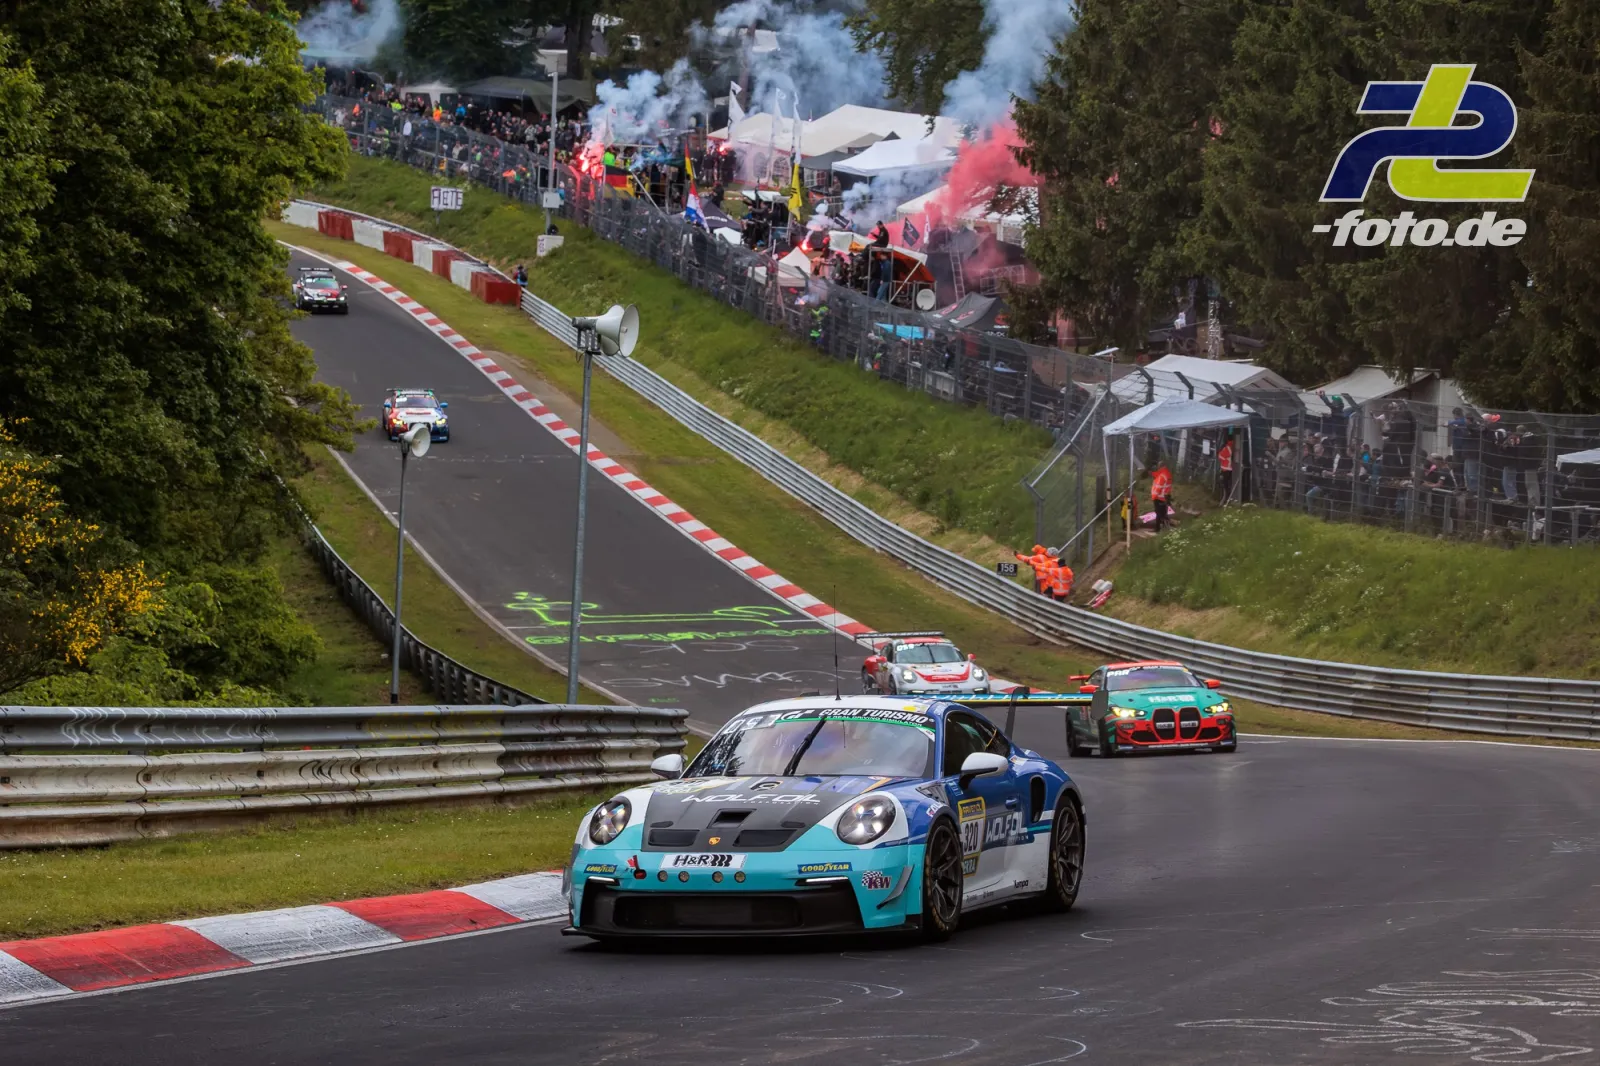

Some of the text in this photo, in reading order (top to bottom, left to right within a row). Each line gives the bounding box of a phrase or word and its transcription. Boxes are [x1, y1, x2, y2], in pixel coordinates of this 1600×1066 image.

[1001, 563, 1015, 573] 158
[819, 708, 858, 718] GRAN
[863, 709, 929, 725] TURISMO
[681, 793, 820, 803] WOLFOIL
[963, 821, 979, 853] 320
[673, 854, 710, 867] H&R
[801, 862, 849, 872] GOODYEAR
[868, 876, 891, 889] KW
